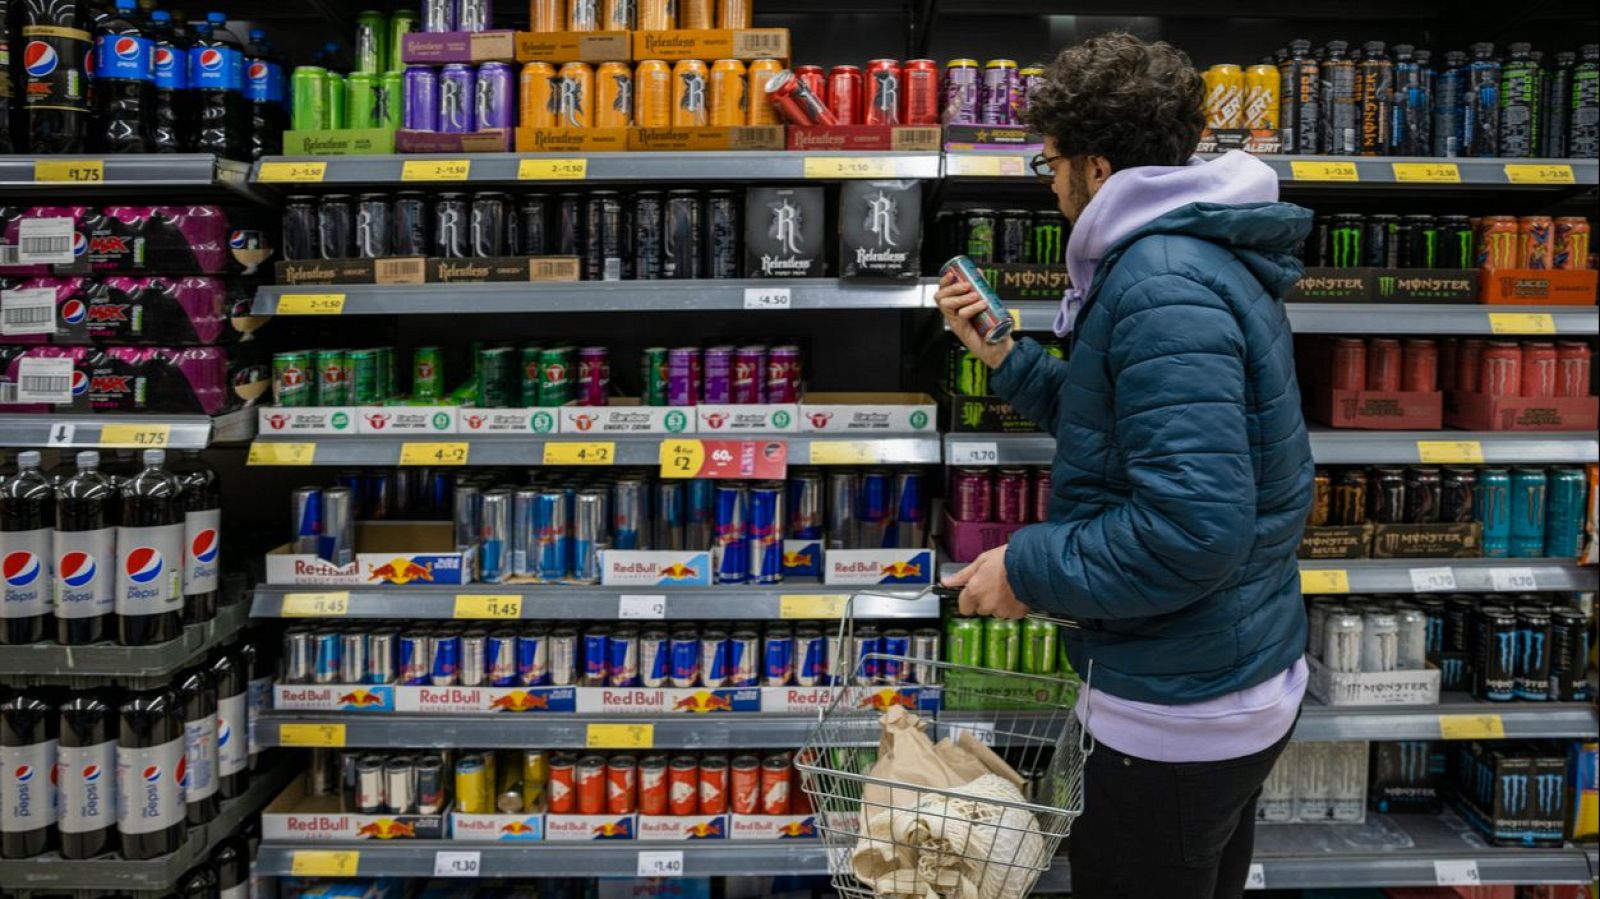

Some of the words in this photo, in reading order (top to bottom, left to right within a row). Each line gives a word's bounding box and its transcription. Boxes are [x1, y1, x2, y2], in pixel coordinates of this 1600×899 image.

[442, 77, 461, 129] R
[559, 75, 582, 128] R
[535, 130, 585, 149] Relentless
[69, 169, 99, 181] £1.75
[869, 189, 896, 247] R
[438, 206, 464, 258] R
[774, 198, 801, 254] R
[856, 246, 908, 269] Relentless
[761, 253, 812, 276] Relentless
[1004, 269, 1069, 288] MONST
[1399, 277, 1471, 291] MONSTER
[135, 432, 165, 444] £1.75
[435, 449, 443, 460] 4
[578, 449, 586, 459] 4
[970, 450, 996, 461] £1.70
[674, 456, 691, 470] £2
[1401, 534, 1461, 543] MONSTER
[613, 563, 634, 573] Red
[636, 563, 656, 573] Bull
[835, 562, 856, 573] Red
[858, 562, 878, 573] Bull
[127, 588, 159, 600] pepsi
[488, 603, 517, 615] £1.45
[653, 604, 664, 614] £2
[1362, 682, 1429, 692] MONSTER
[282, 690, 306, 701] Red
[308, 690, 331, 701] Bull
[420, 690, 449, 703] Red
[452, 690, 480, 703] Bull
[603, 691, 632, 705] Red
[635, 691, 664, 705] Bull
[788, 690, 817, 704] Red
[288, 818, 317, 830] Red
[320, 818, 348, 830] Bull
[452, 860, 477, 871] £1.30
[654, 861, 680, 871] £1.40
